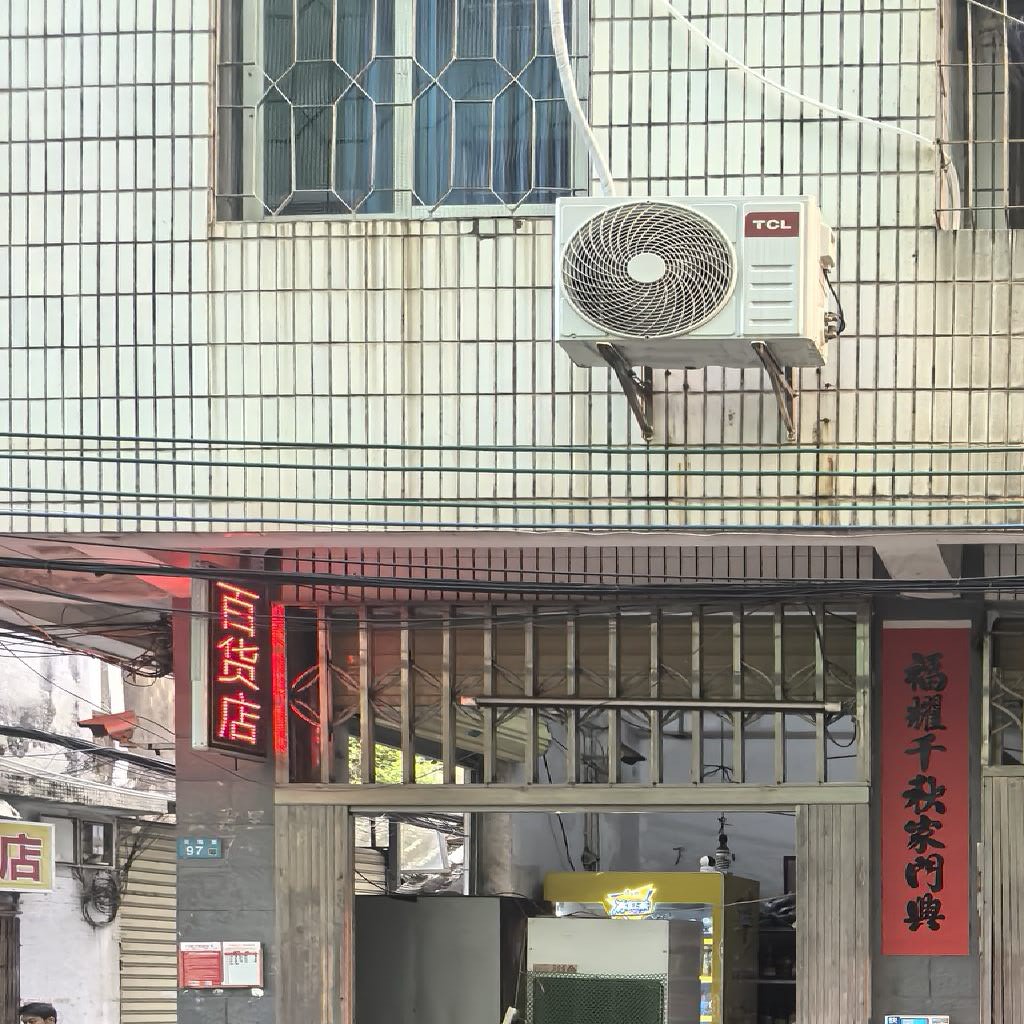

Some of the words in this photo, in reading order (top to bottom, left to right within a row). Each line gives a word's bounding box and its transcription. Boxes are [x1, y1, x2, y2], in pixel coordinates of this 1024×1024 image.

[753, 219, 792, 230] TCL
[216, 581, 261, 744] 百货店
[0, 833, 42, 881] 店
[186, 845, 204, 856] 97
